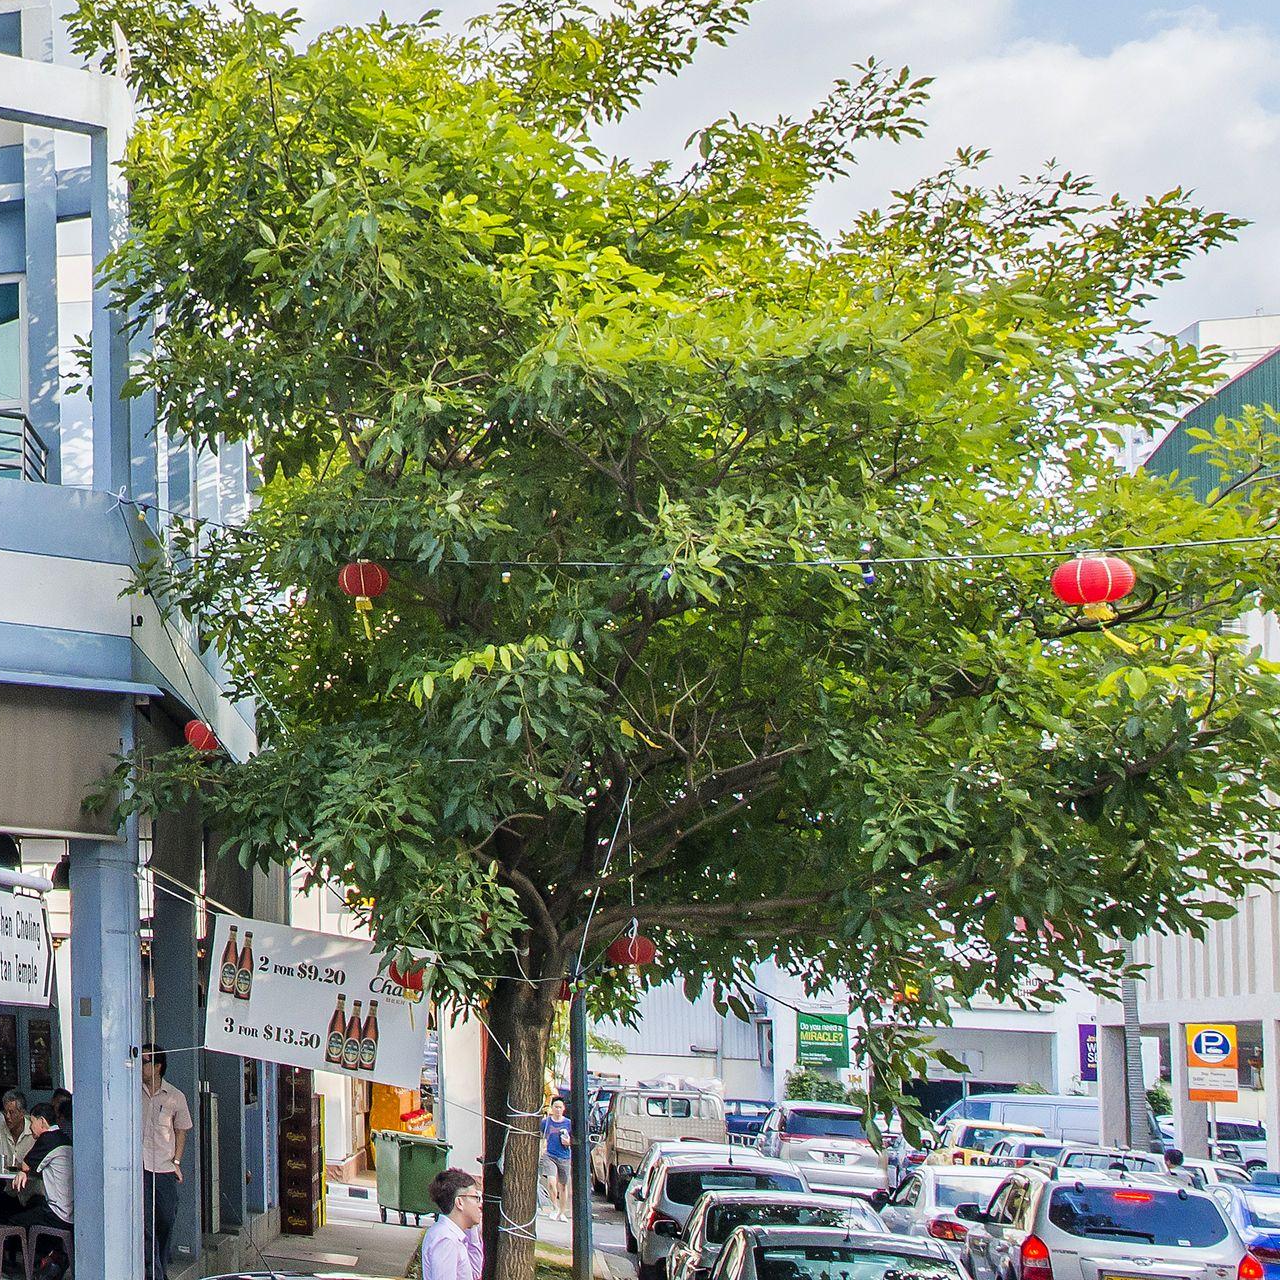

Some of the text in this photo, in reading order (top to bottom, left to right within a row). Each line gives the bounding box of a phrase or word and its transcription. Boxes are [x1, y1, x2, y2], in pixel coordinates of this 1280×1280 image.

[15, 910, 41, 951] Choling
[14, 954, 38, 992] Temple
[258, 955, 346, 986] 2 FOR $9.20
[368, 976, 424, 1004] Chag
[224, 1017, 321, 1049] 3 FOR $13.50
[800, 1022, 808, 1031] Do
[800, 1031, 844, 1042] MIRACLE?
